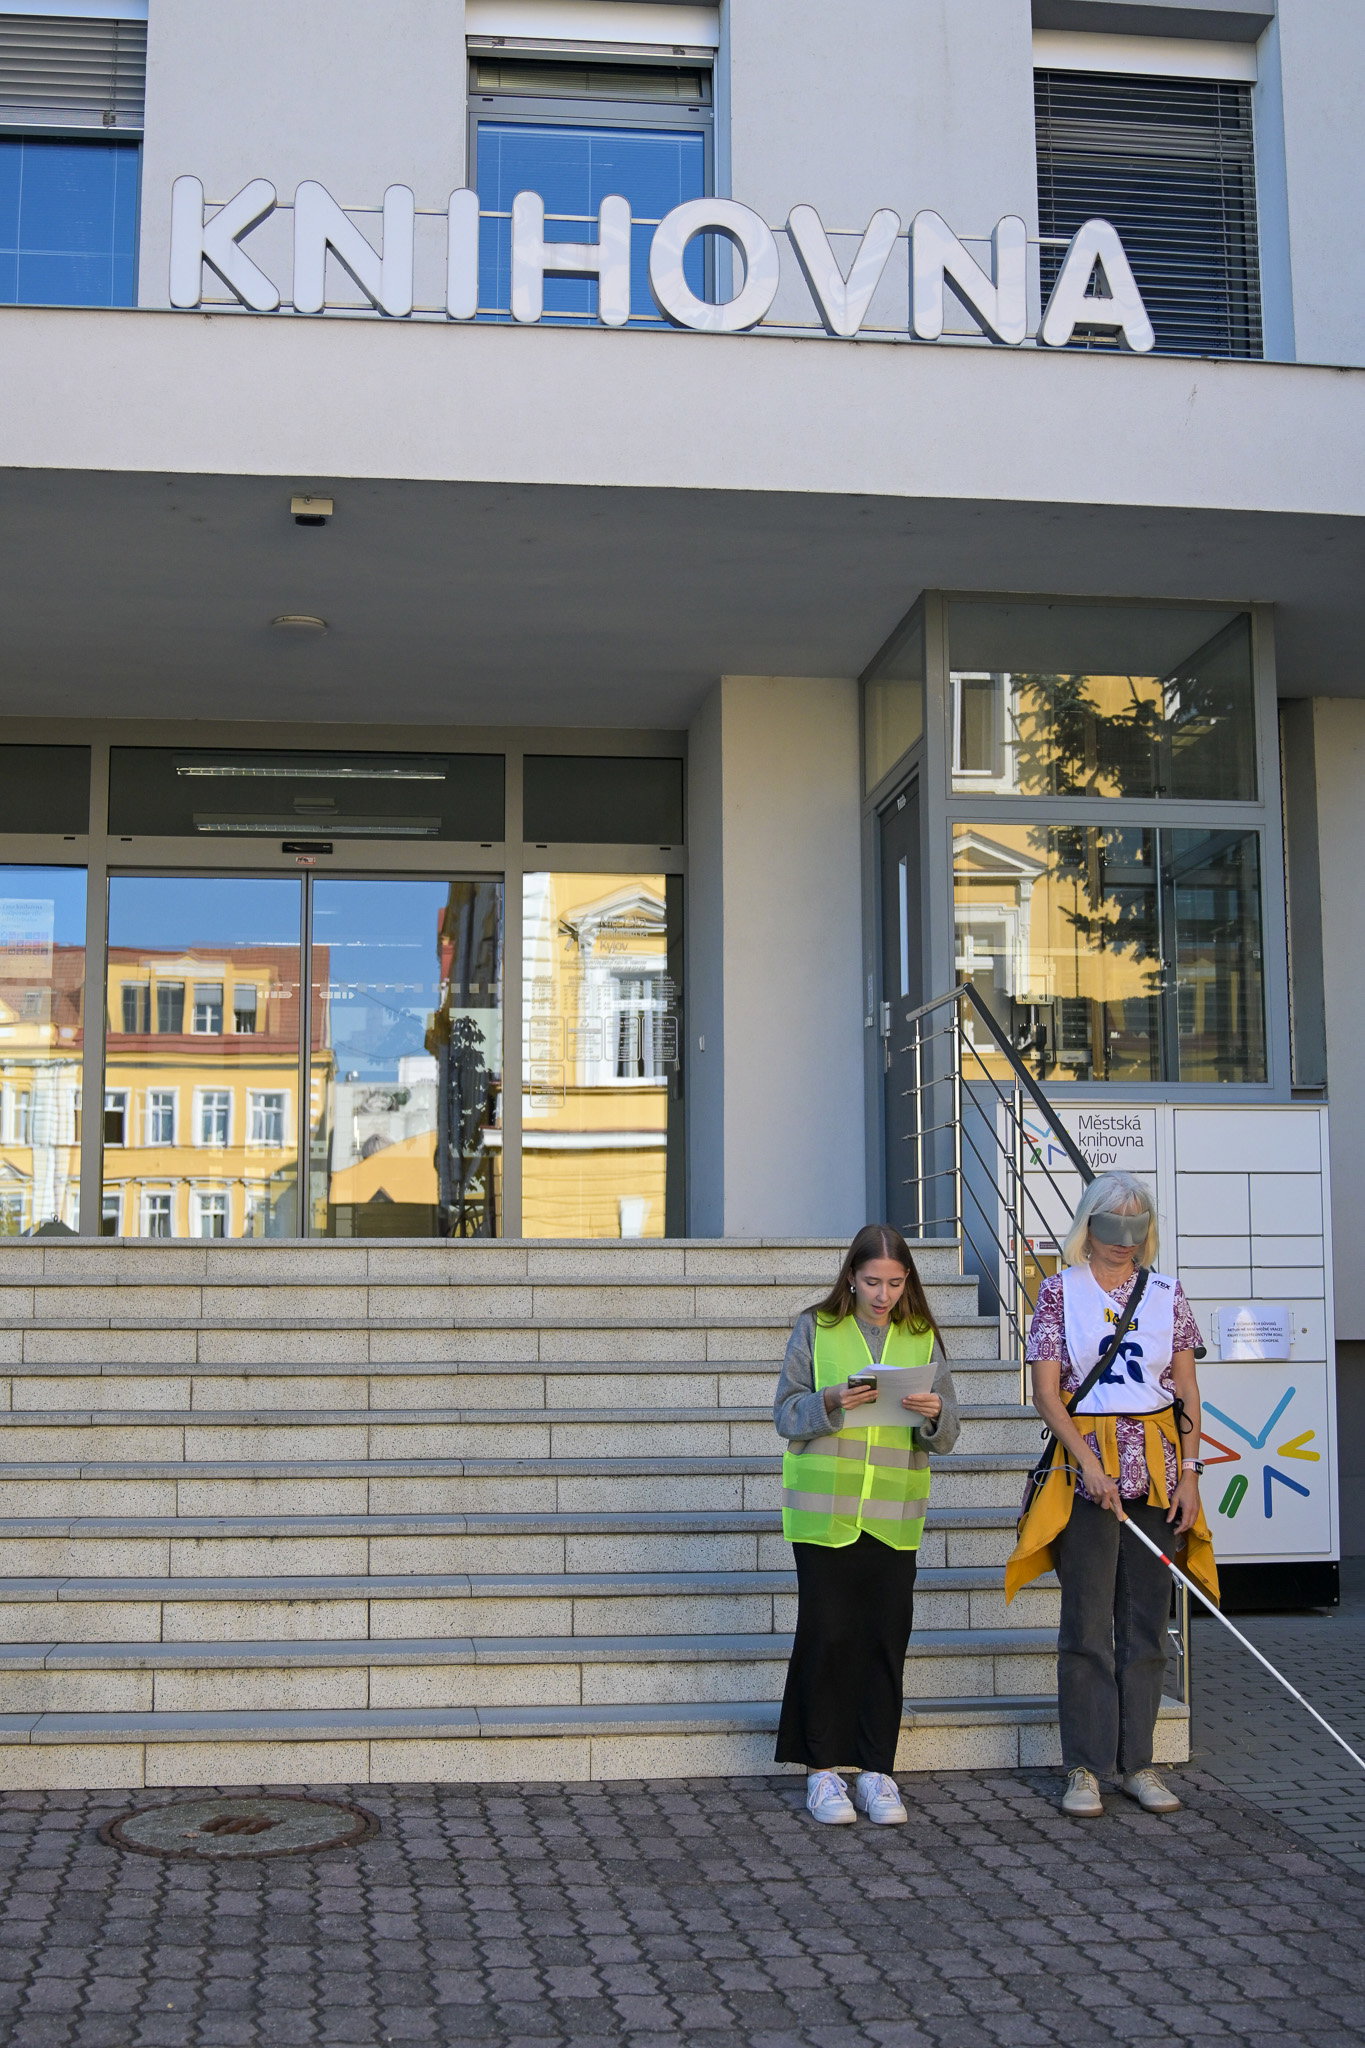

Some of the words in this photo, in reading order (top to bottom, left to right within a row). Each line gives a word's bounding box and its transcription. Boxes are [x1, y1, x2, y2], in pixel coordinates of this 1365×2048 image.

[169, 175, 1157, 354] KNIHOVNA
[600, 940, 628, 953] Kyjov
[1078, 1115, 1141, 1131] Městská
[1078, 1131, 1144, 1147] knihovna
